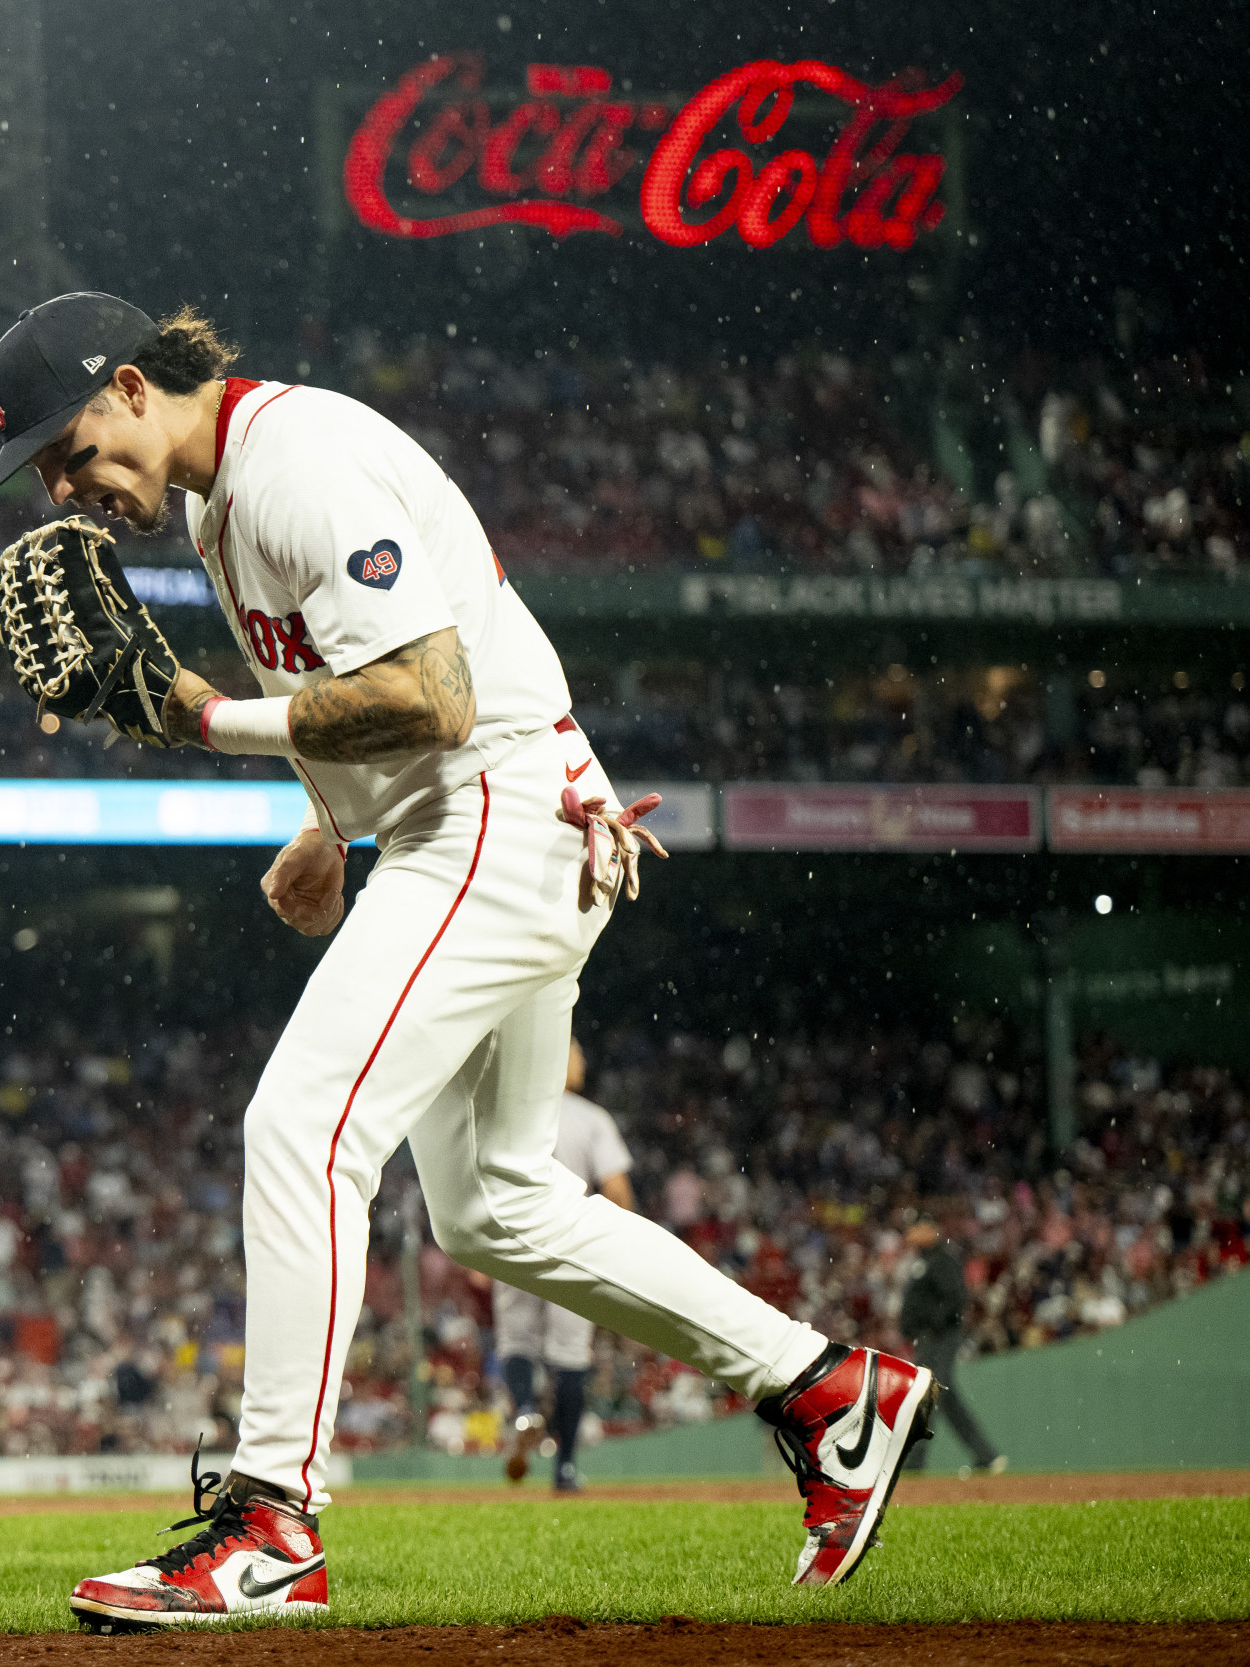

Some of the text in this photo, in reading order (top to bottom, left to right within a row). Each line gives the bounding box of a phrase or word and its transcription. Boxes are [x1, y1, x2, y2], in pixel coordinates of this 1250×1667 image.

[362, 550, 398, 580] 49
[869, 576, 975, 617] LIVES
[980, 578, 1122, 621] MATTER
